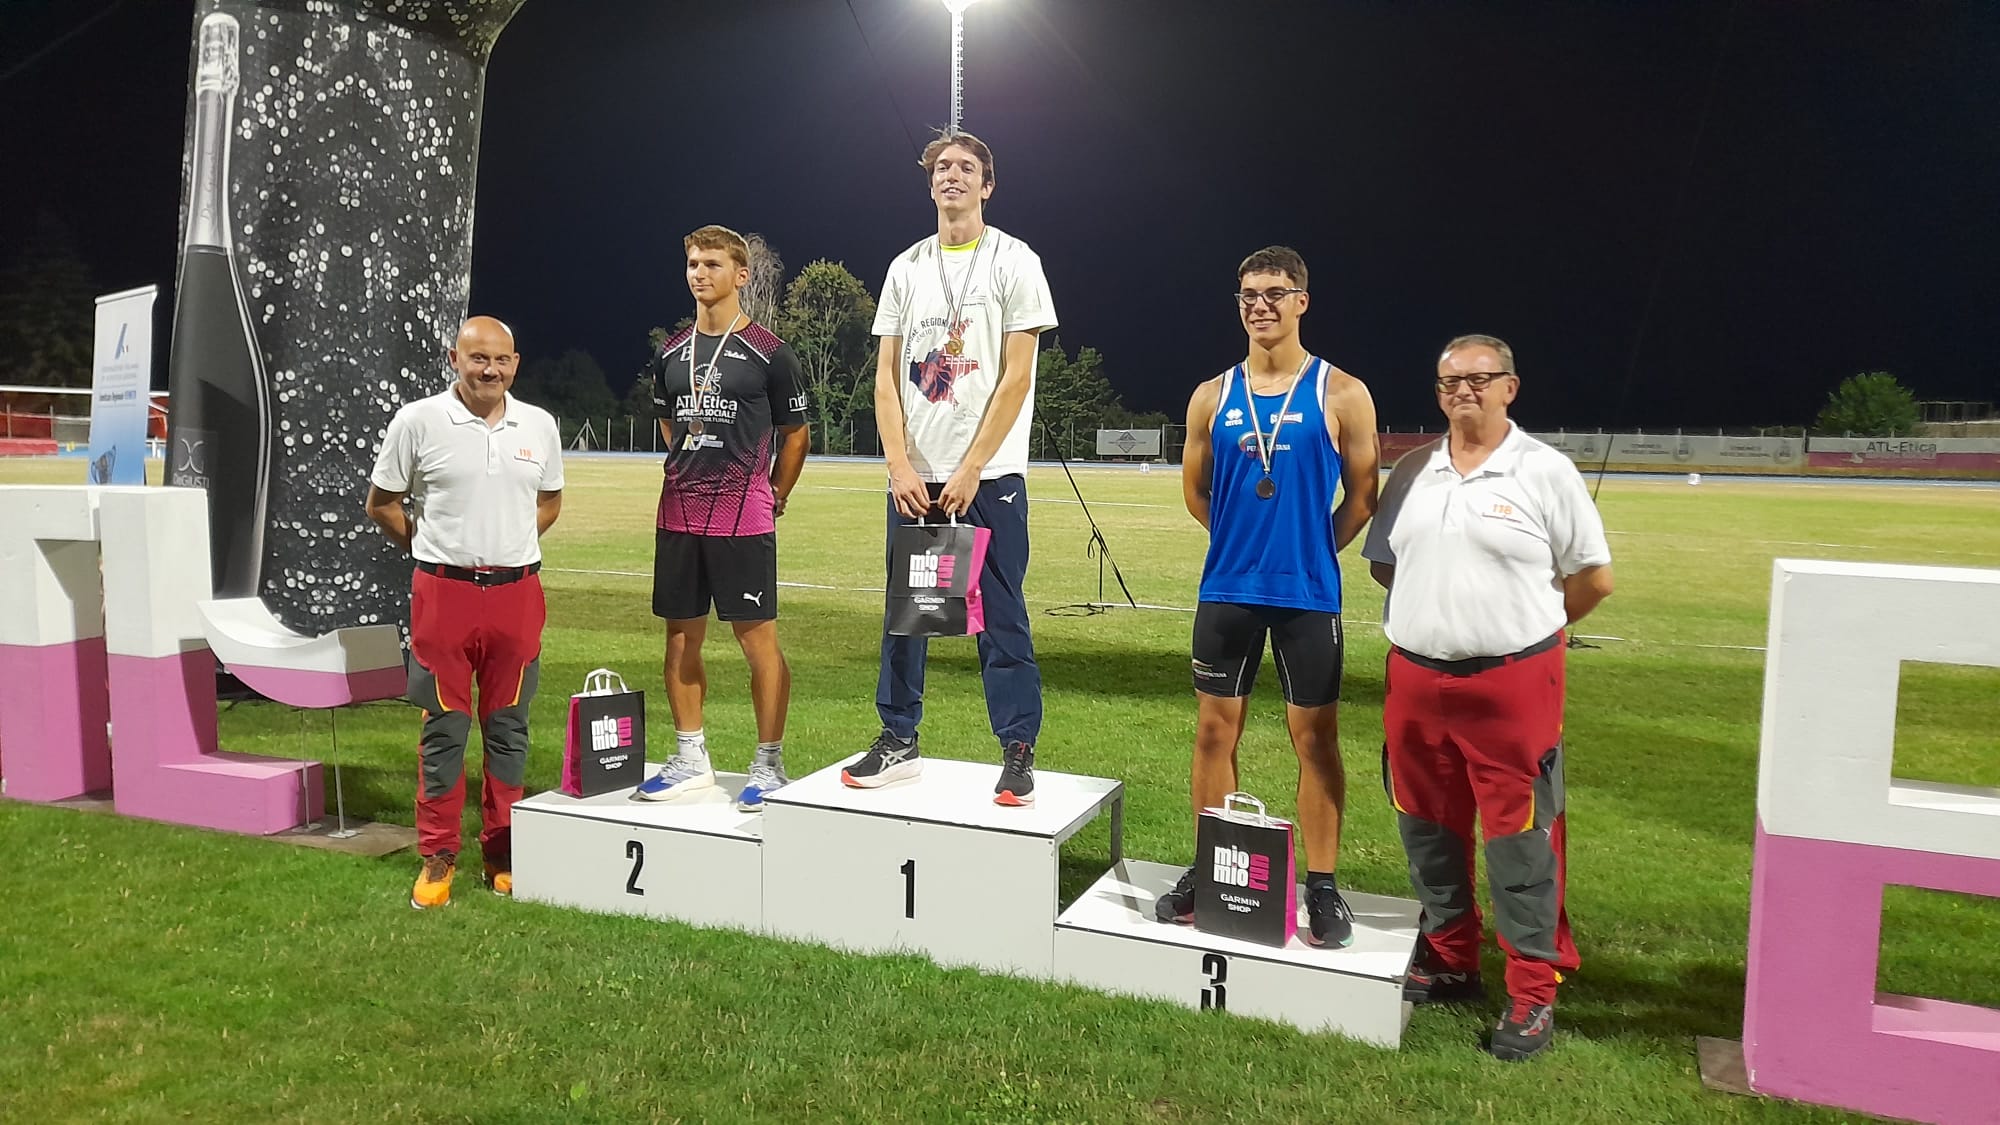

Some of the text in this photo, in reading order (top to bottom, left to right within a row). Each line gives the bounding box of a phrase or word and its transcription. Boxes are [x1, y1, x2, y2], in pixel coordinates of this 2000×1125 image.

[704, 409, 737, 419] SOCIALE
[1866, 441, 1937, 453] ATL-Etica
[1493, 504, 1513, 514] 118
[910, 550, 938, 571] mio
[909, 570, 938, 588] mio
[591, 715, 617, 736] mio
[592, 732, 619, 752] mio
[1214, 845, 1250, 869] mio
[625, 840, 645, 896] 2
[1213, 864, 1249, 888] mio
[1248, 853, 1270, 892] run
[900, 859, 915, 919] 1
[1220, 893, 1260, 908] GARMIN
[1227, 903, 1251, 914] SHOP
[1201, 953, 1227, 1012] 3
